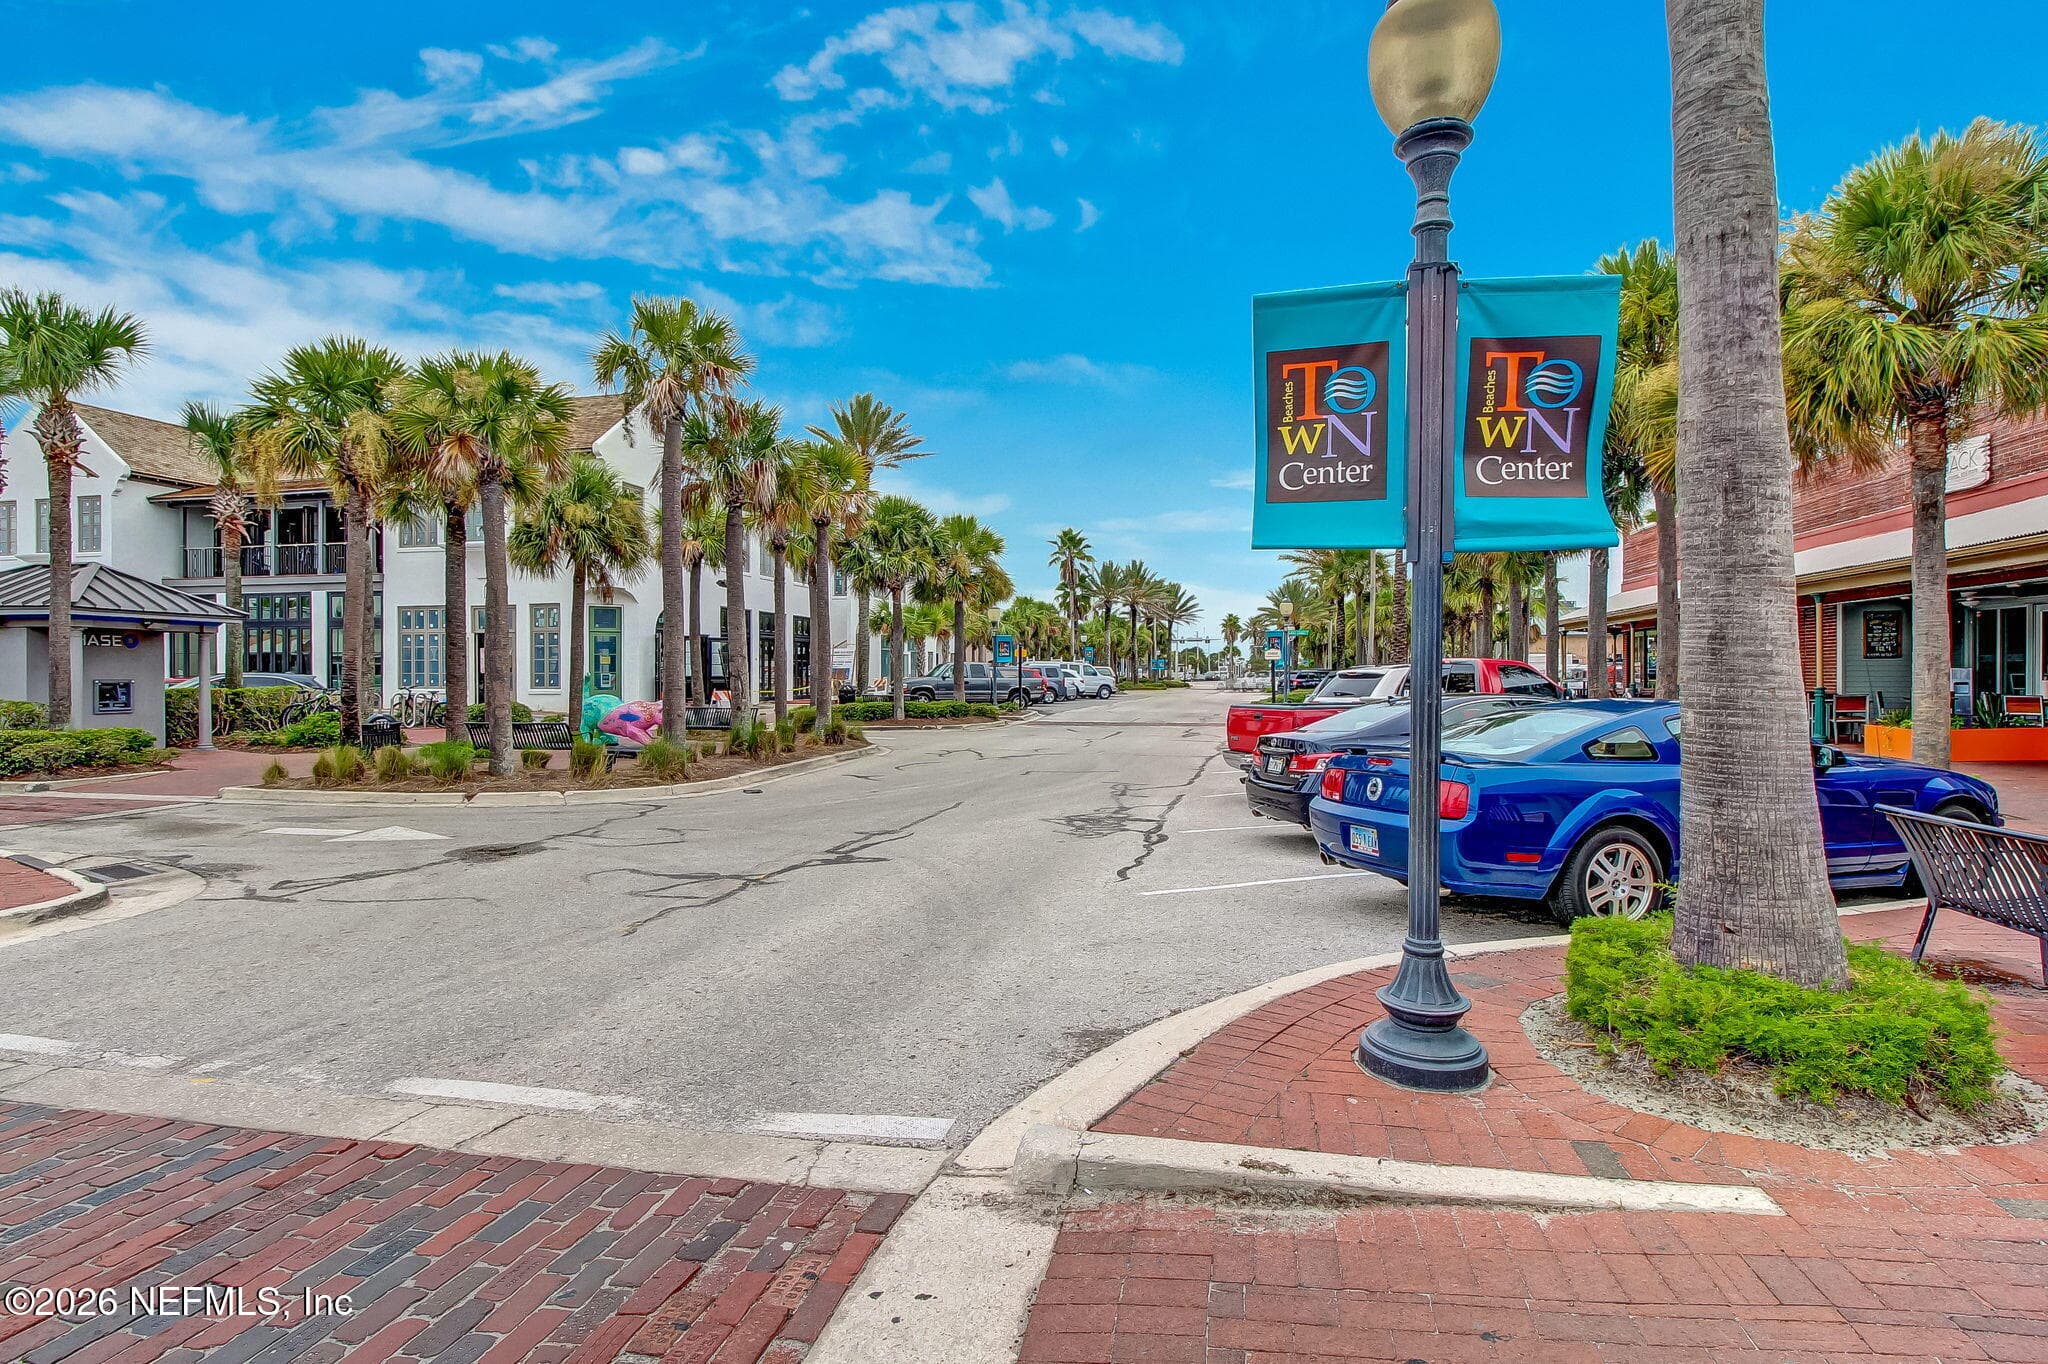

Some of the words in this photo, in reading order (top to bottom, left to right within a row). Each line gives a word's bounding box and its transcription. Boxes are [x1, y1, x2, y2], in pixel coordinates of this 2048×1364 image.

[1282, 381, 1294, 423] Beaches
[1482, 369, 1497, 413] Beaches
[1476, 456, 1572, 485] Center
[1951, 448, 1978, 472] ACK
[1279, 462, 1373, 491] Center
